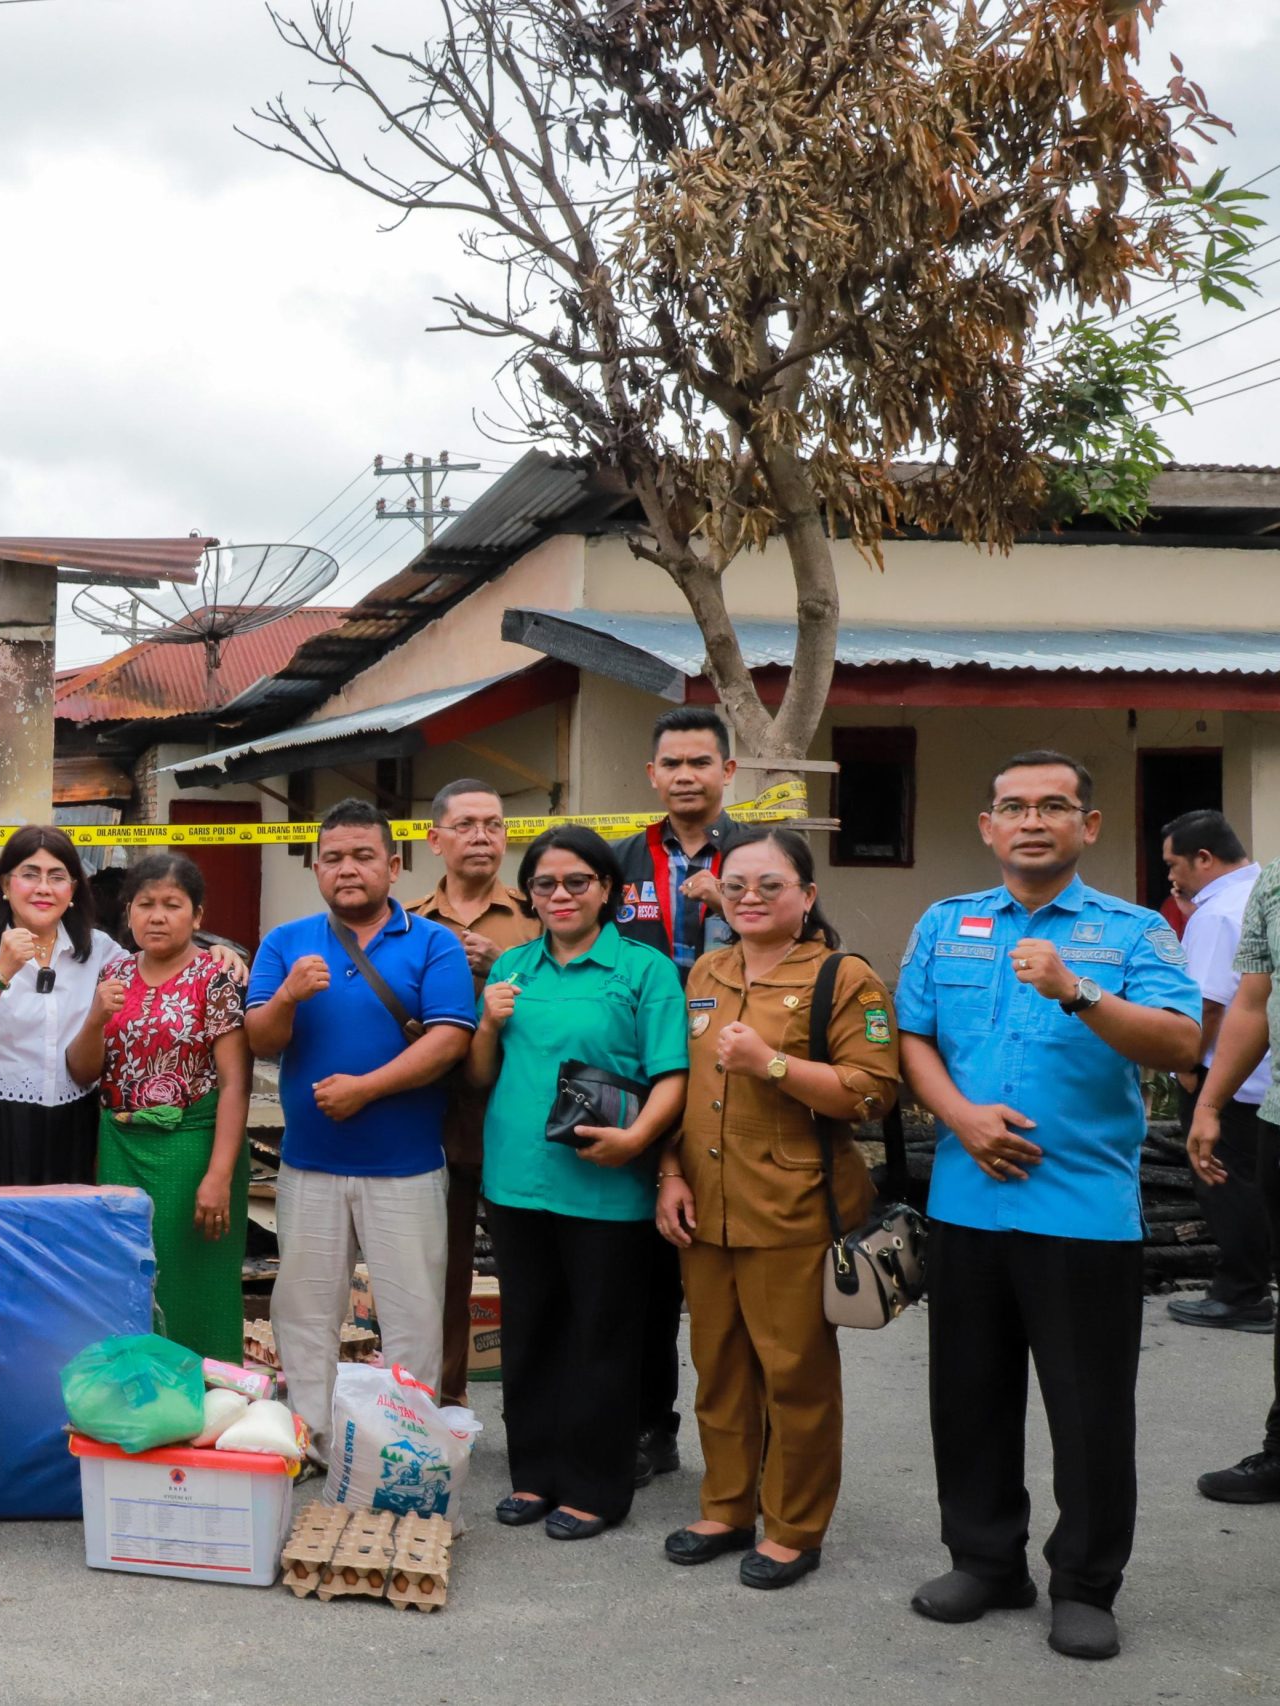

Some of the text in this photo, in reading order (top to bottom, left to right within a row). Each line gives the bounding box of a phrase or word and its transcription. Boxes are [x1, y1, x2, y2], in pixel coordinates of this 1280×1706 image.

[413, 822, 431, 830] DILAR
[523, 819, 545, 827] POLISI
[134, 828, 167, 836] MELINTAS
[213, 827, 236, 835] POLISI
[257, 825, 321, 834] DILARANG MELINTA
[638, 905, 659, 918] RESCUE
[1062, 949, 1119, 960] DISDUKCAPIL
